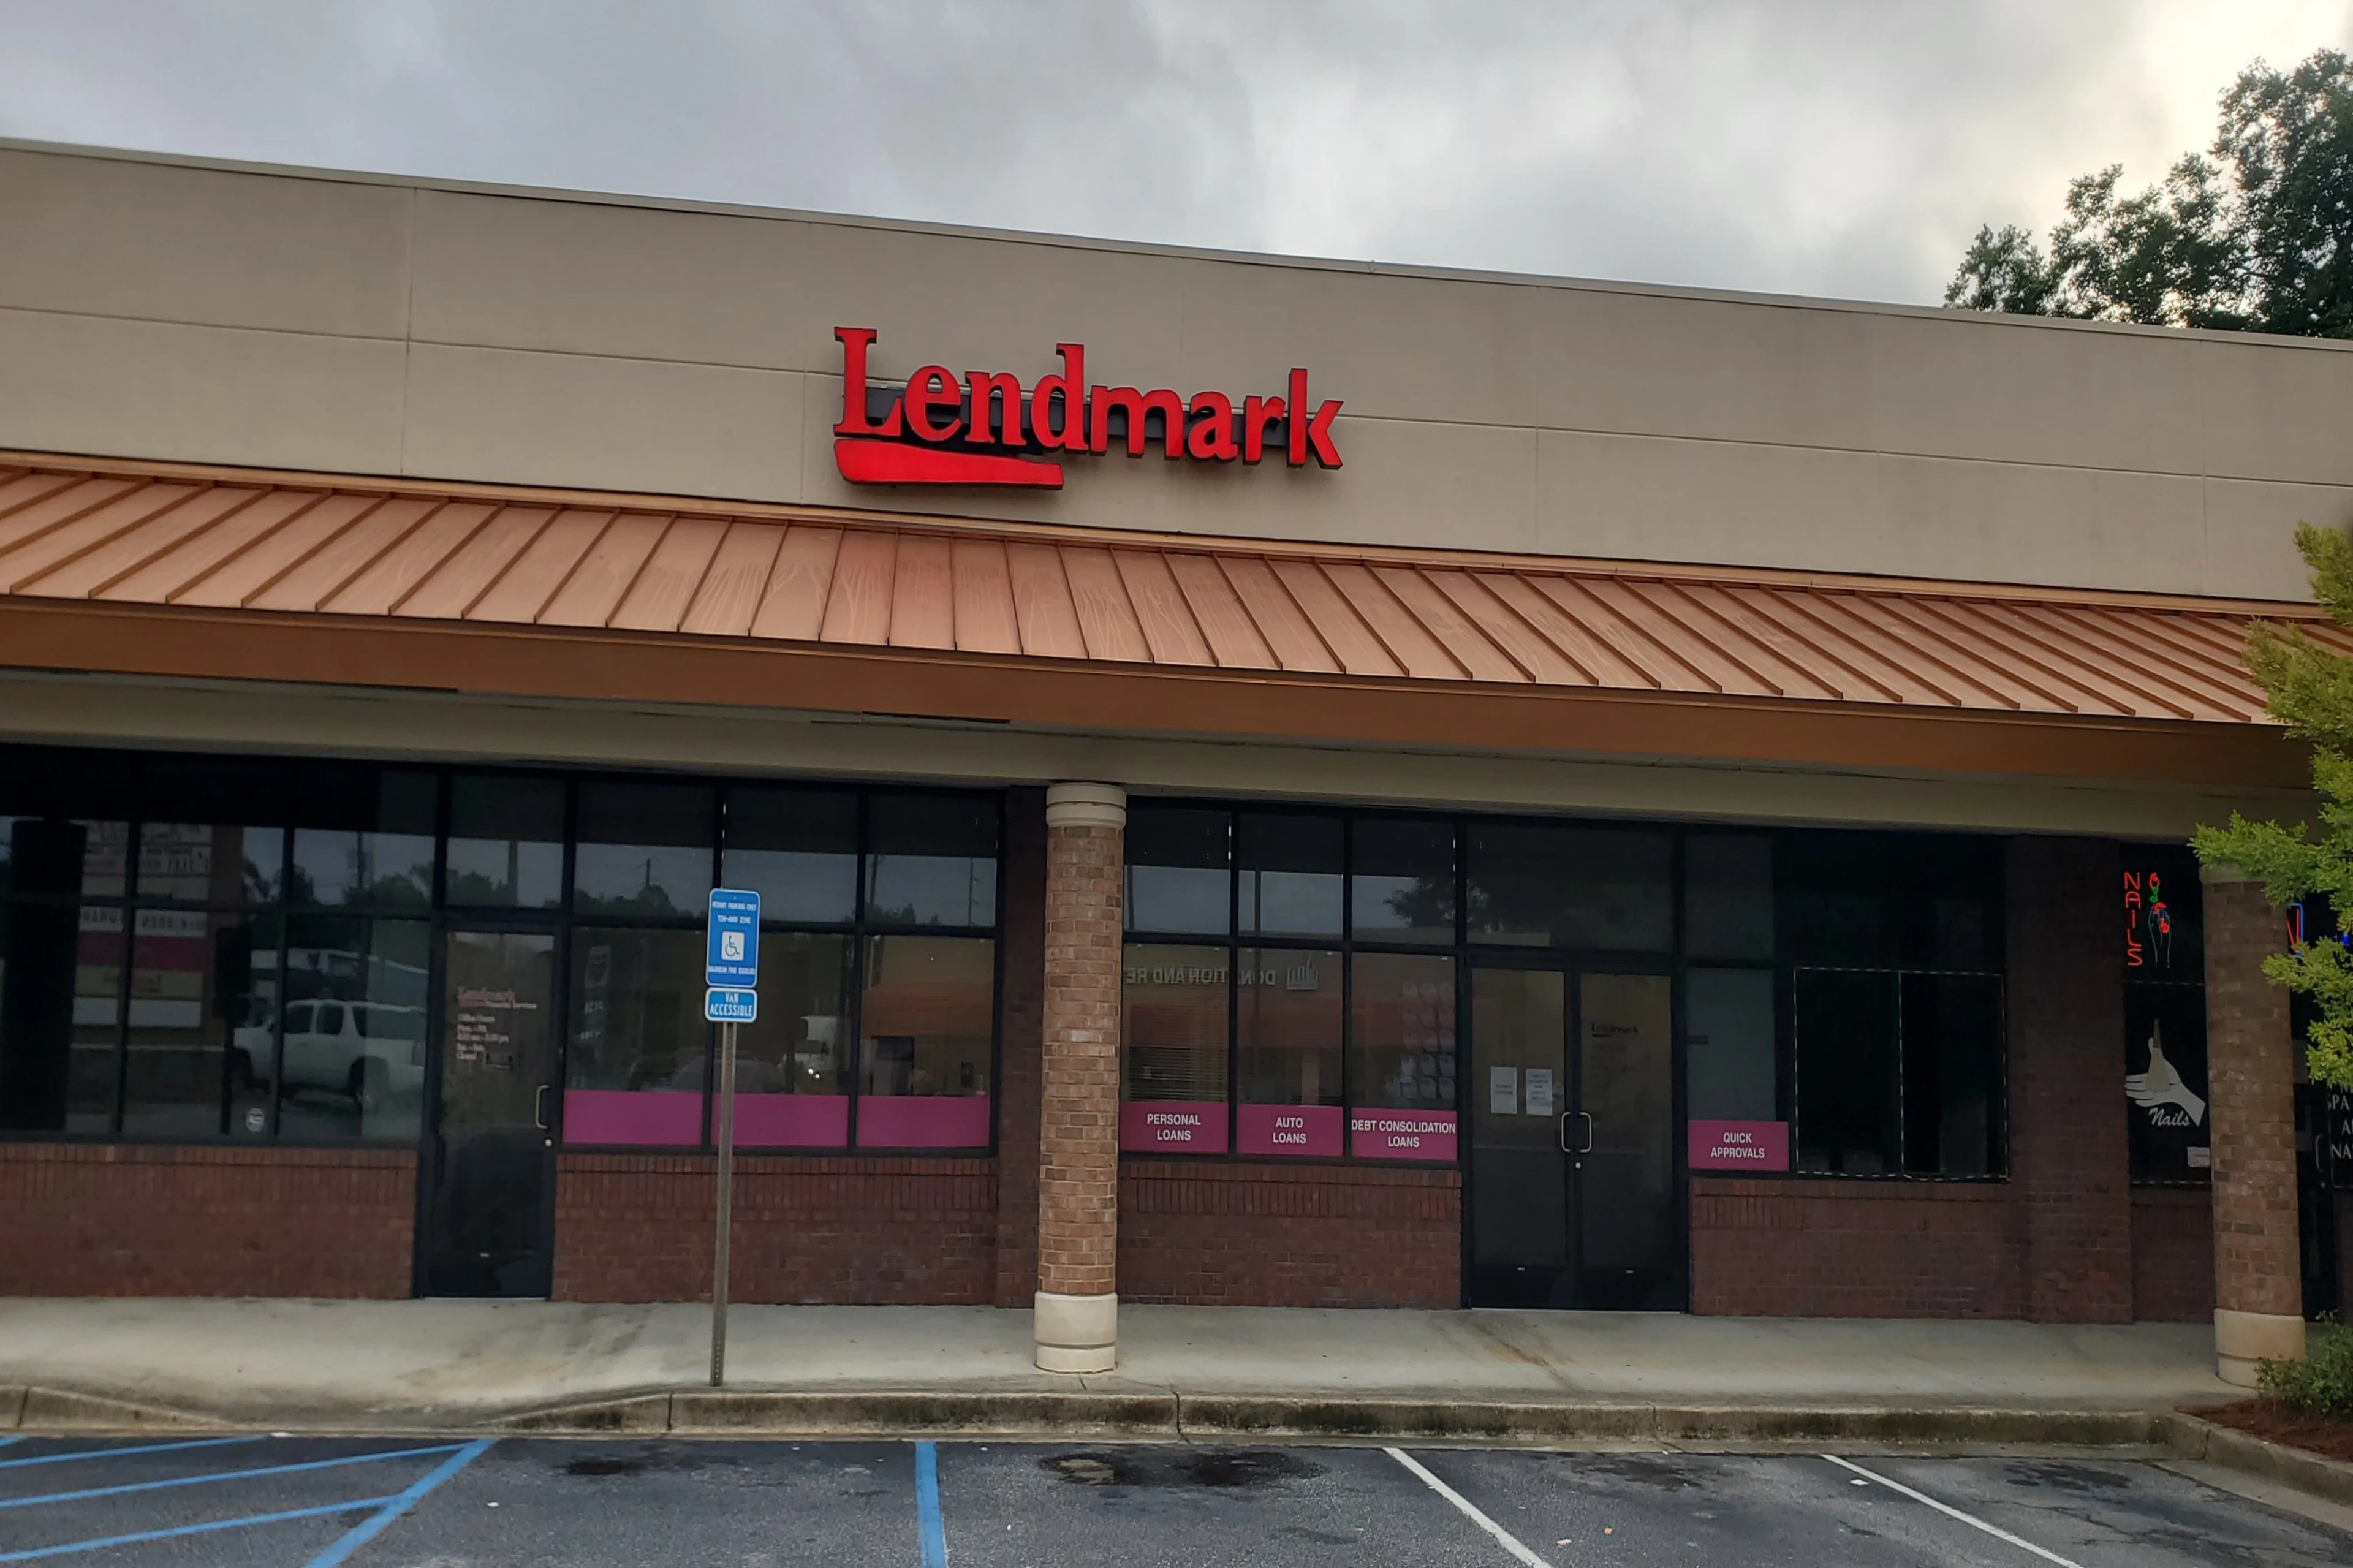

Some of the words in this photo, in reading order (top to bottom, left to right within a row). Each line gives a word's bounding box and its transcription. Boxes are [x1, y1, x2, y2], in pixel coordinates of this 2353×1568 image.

[833, 327, 1343, 469] Lendmark
[2123, 871, 2143, 966] NAILS
[725, 992, 739, 1004] VAN
[710, 1004, 753, 1017] ACCESSIBLE
[1146, 1114, 1201, 1126] PERSONAL
[1275, 1117, 1303, 1129] AUTO
[2148, 1107, 2191, 1127] Nails
[1351, 1119, 1377, 1131] DEBT
[1379, 1120, 1455, 1134] CONSOLIDATION
[1156, 1129, 1191, 1141] LOANS
[1272, 1132, 1306, 1144] LOANS
[1723, 1132, 1752, 1144] QUICK
[1387, 1136, 1420, 1148] LOANS
[1711, 1146, 1765, 1159] APPROVALS
